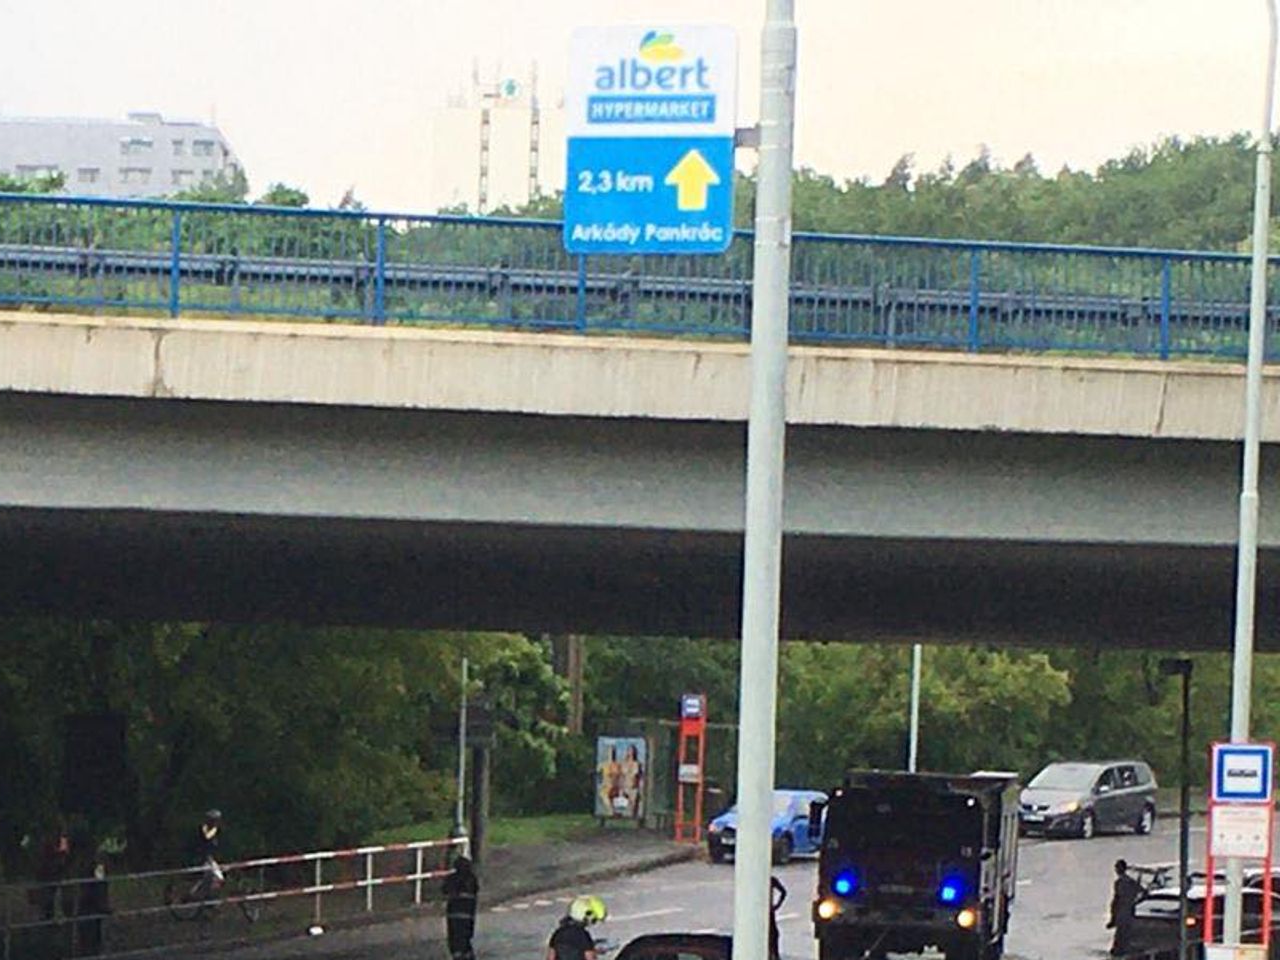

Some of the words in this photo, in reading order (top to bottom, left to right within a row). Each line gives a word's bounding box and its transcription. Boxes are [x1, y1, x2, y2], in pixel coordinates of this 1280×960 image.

[595, 57, 710, 90] albert
[591, 101, 710, 119] HYPERMARKET
[577, 170, 613, 194] 2,3
[616, 170, 654, 192] km
[572, 222, 641, 245] Arkády
[645, 222, 723, 242] Pankrác
